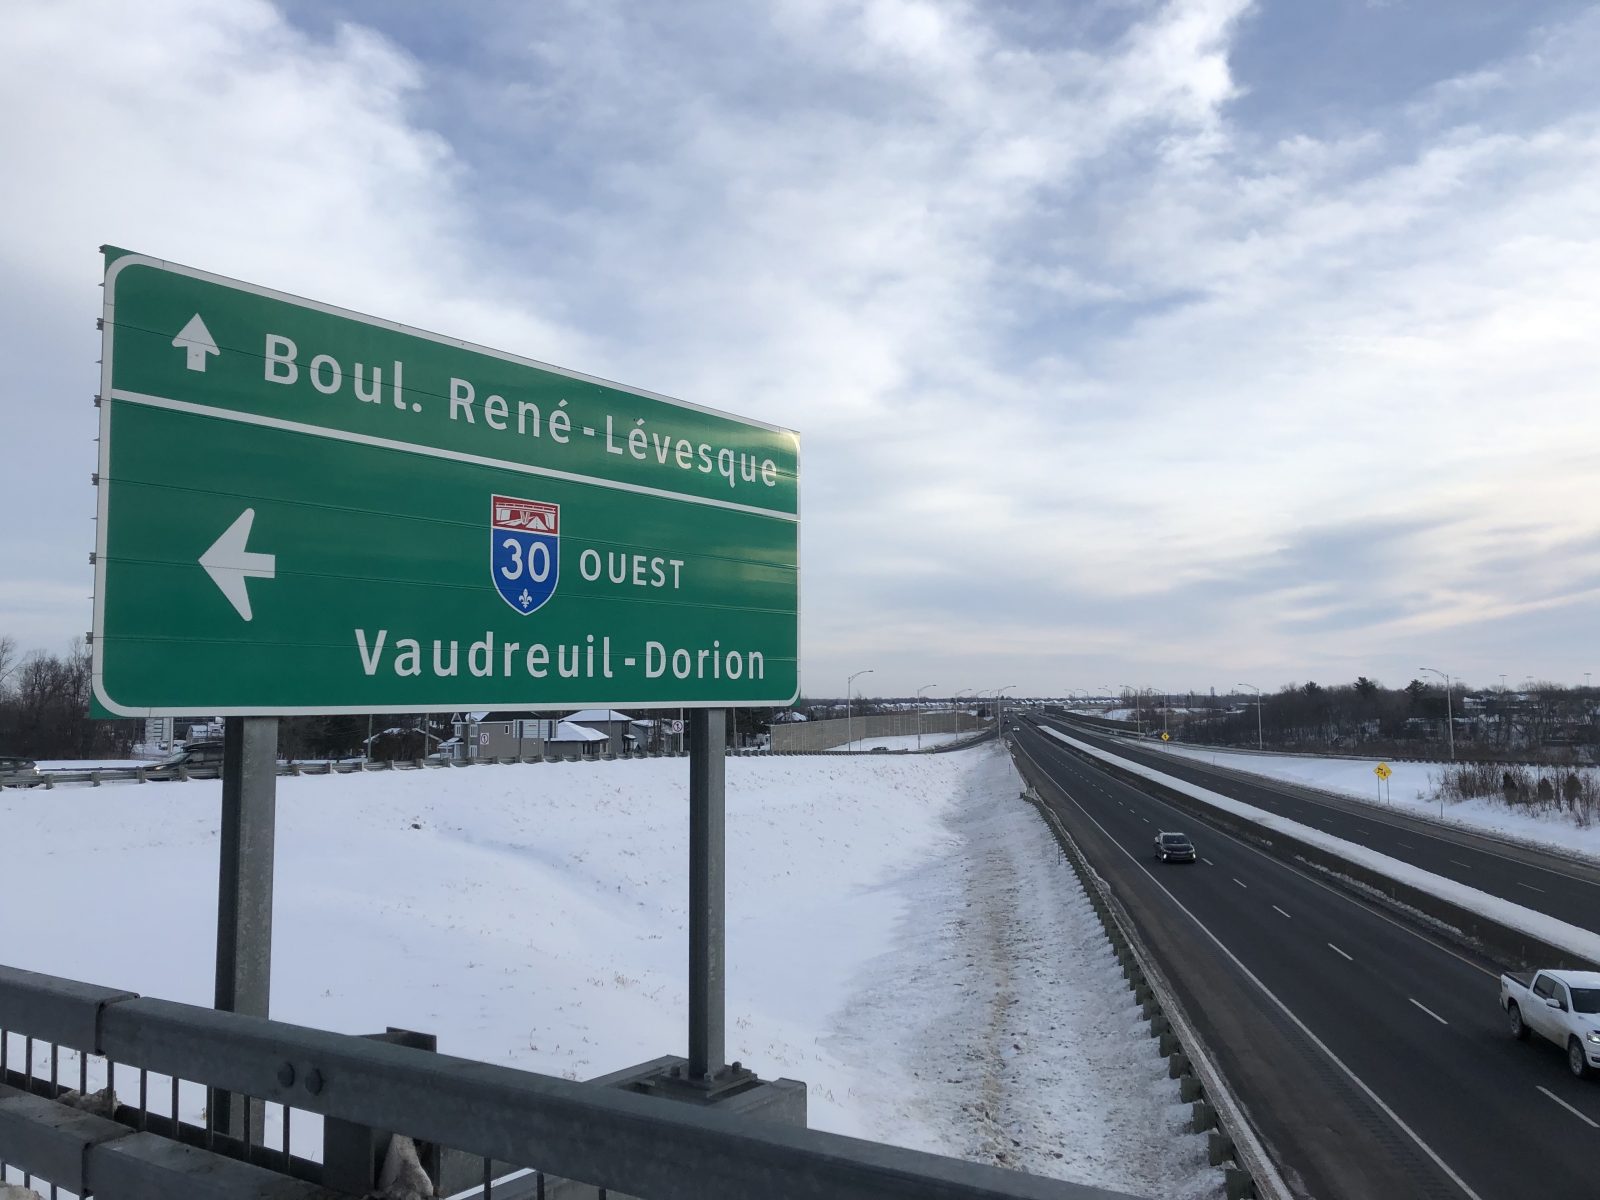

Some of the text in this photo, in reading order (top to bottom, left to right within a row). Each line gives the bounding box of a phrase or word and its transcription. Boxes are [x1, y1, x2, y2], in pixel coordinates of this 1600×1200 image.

[264, 333, 778, 488] Boul. René-Lévesque
[501, 538, 685, 589] 30 OUEST
[354, 628, 765, 680] Vaudreuil-Dorion
